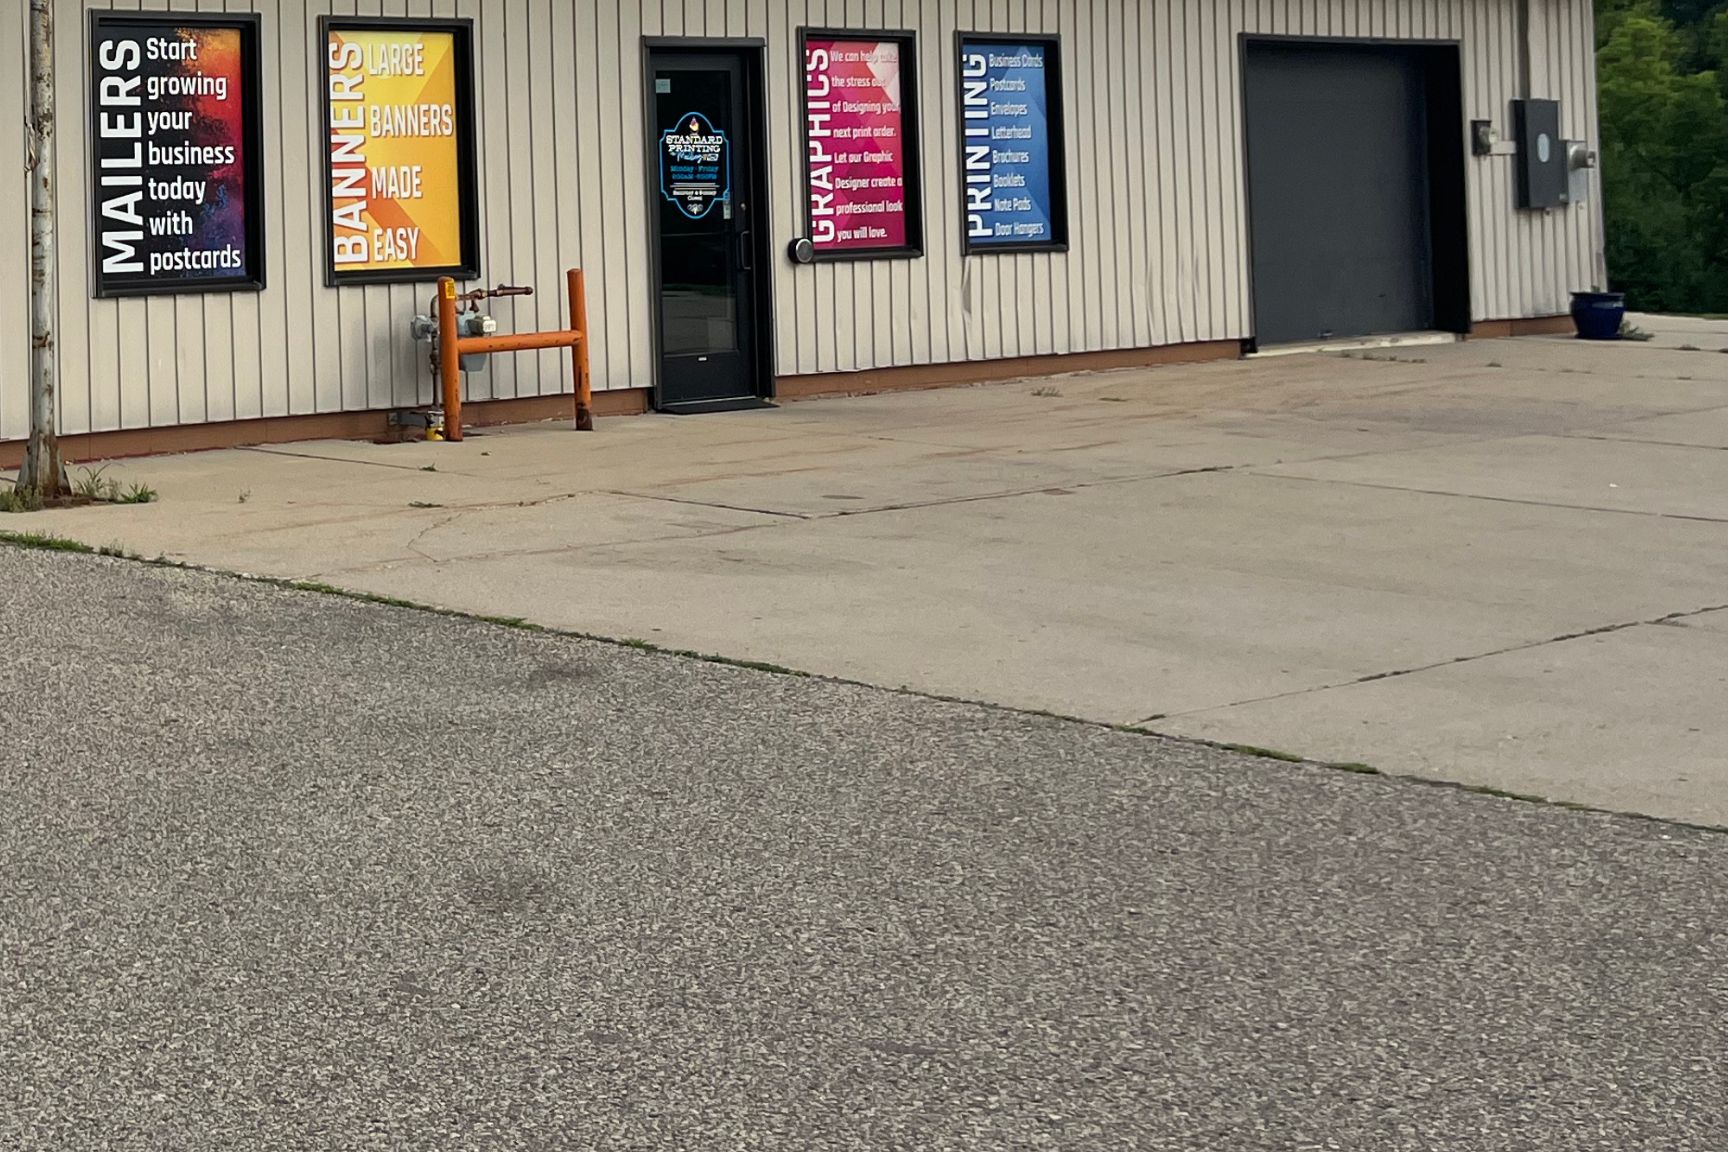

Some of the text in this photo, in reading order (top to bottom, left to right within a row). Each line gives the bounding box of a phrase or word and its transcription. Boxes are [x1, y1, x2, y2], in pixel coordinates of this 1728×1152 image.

[147, 38, 197, 60] Start
[831, 50, 843, 61] We
[845, 52, 859, 61] can
[368, 43, 424, 75] LARGE
[989, 53, 1043, 67] Business Cards
[147, 75, 227, 100] growing
[831, 76, 845, 87] the
[846, 77, 870, 87] stress
[990, 77, 1025, 91] Postcards
[832, 101, 841, 112] of
[843, 101, 881, 114] Designing
[991, 101, 1028, 117] Envelopes
[148, 111, 192, 134] your
[370, 104, 453, 137] BANNERS
[666, 135, 723, 145] STANDARD
[833, 127, 851, 137] next
[853, 126, 872, 139] print
[992, 125, 1031, 139] Letterhead
[148, 141, 235, 165] business
[329, 41, 368, 262] BANNERS
[668, 145, 721, 153] PRINTING
[806, 49, 834, 242] GRAPHICS
[99, 39, 144, 273] MAILERS
[834, 150, 893, 164] Let our Graphic
[993, 149, 1029, 164] Brochures
[148, 176, 206, 201] today
[372, 165, 423, 198] MADE
[835, 176, 870, 191] Designer
[871, 176, 896, 187] create
[994, 173, 1025, 188] Booklets
[836, 200, 903, 216] professional look
[994, 197, 1031, 211] Note Pads
[150, 211, 193, 235] with
[995, 222, 1044, 237] Door Hangers
[837, 230, 852, 242] you
[853, 226, 867, 238] will
[374, 227, 419, 261] EASY
[150, 245, 241, 275] postcards
